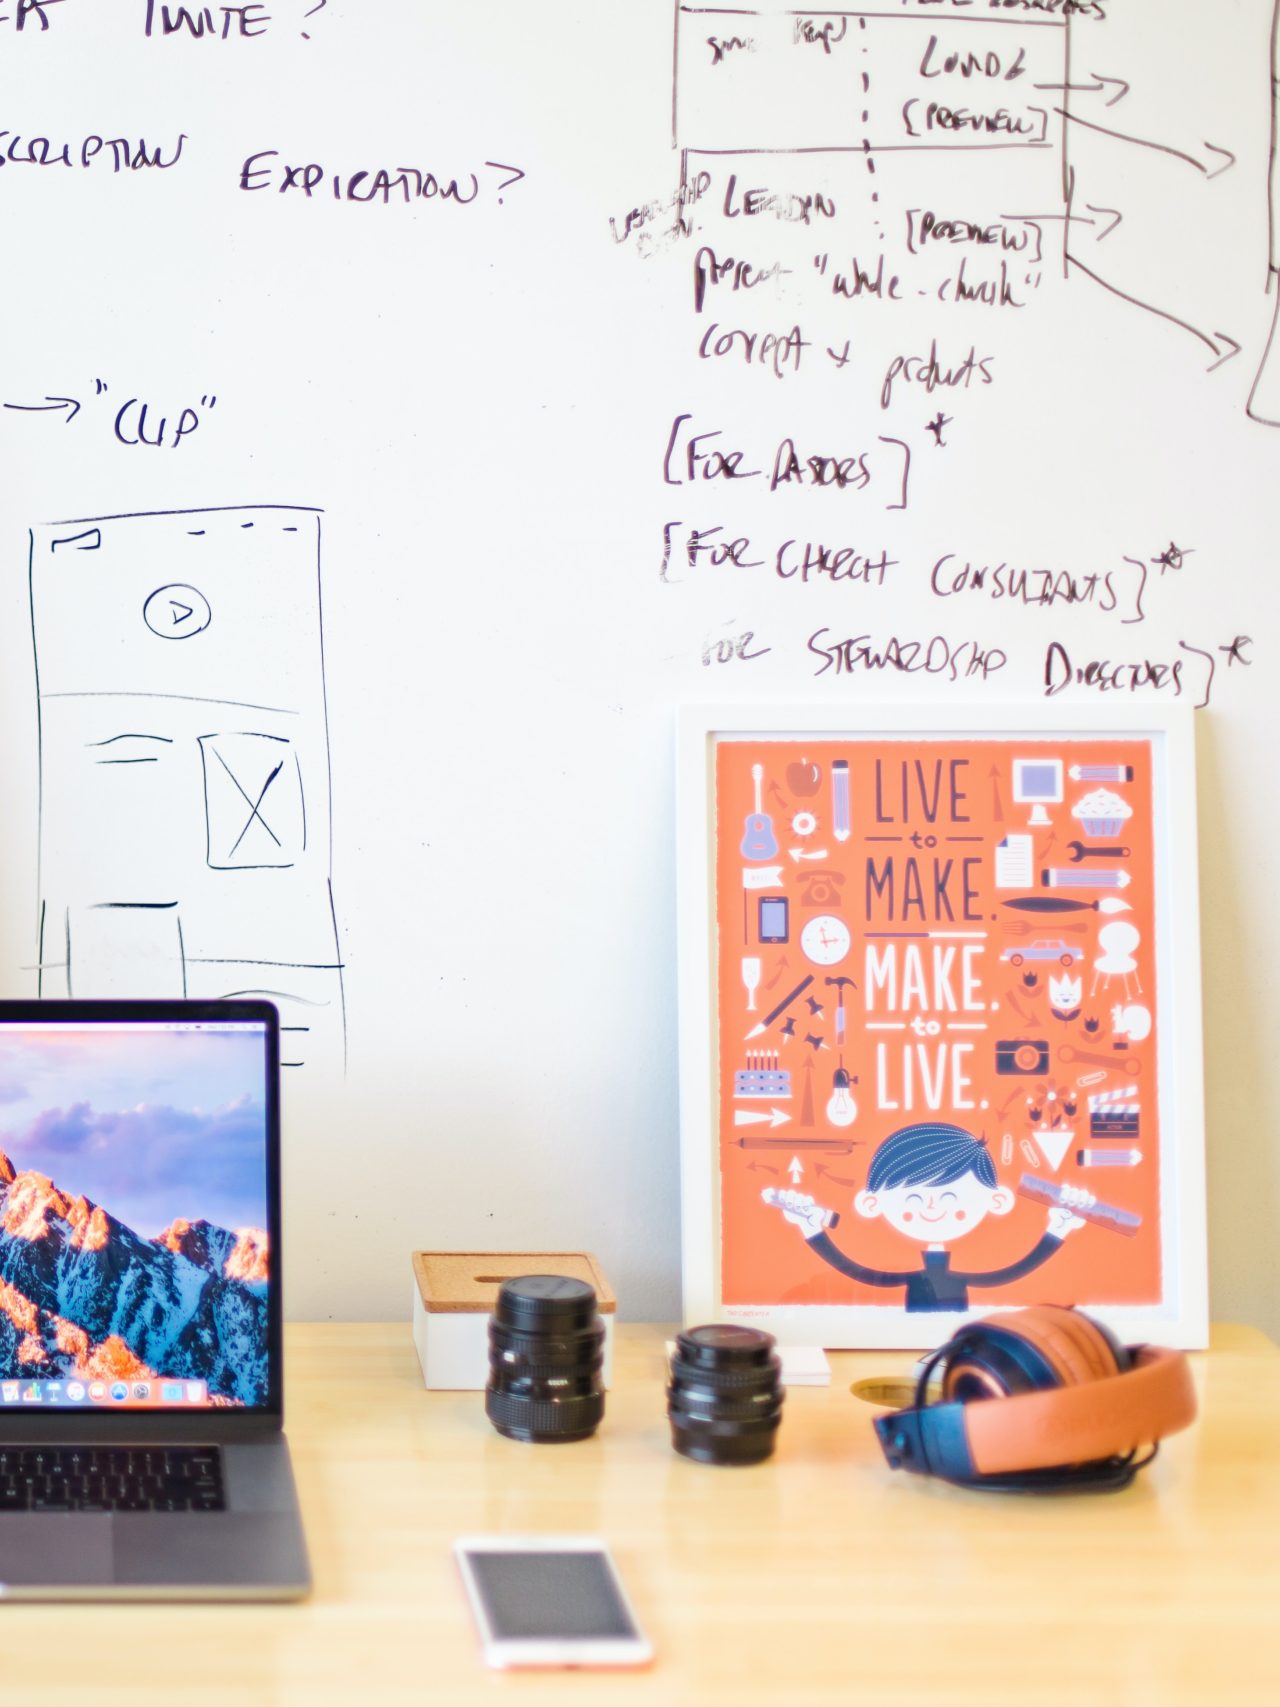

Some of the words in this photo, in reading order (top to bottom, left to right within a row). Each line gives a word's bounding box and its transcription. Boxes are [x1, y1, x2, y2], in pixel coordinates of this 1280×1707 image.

[239, 150, 526, 205] EXPIRATION?
[874, 757, 972, 825] LIVE
[909, 830, 939, 850] to
[864, 856, 999, 923] MAKE.
[864, 943, 1001, 1013] MAKE.
[910, 1016, 942, 1037] to
[876, 1042, 991, 1112] LIVE.
